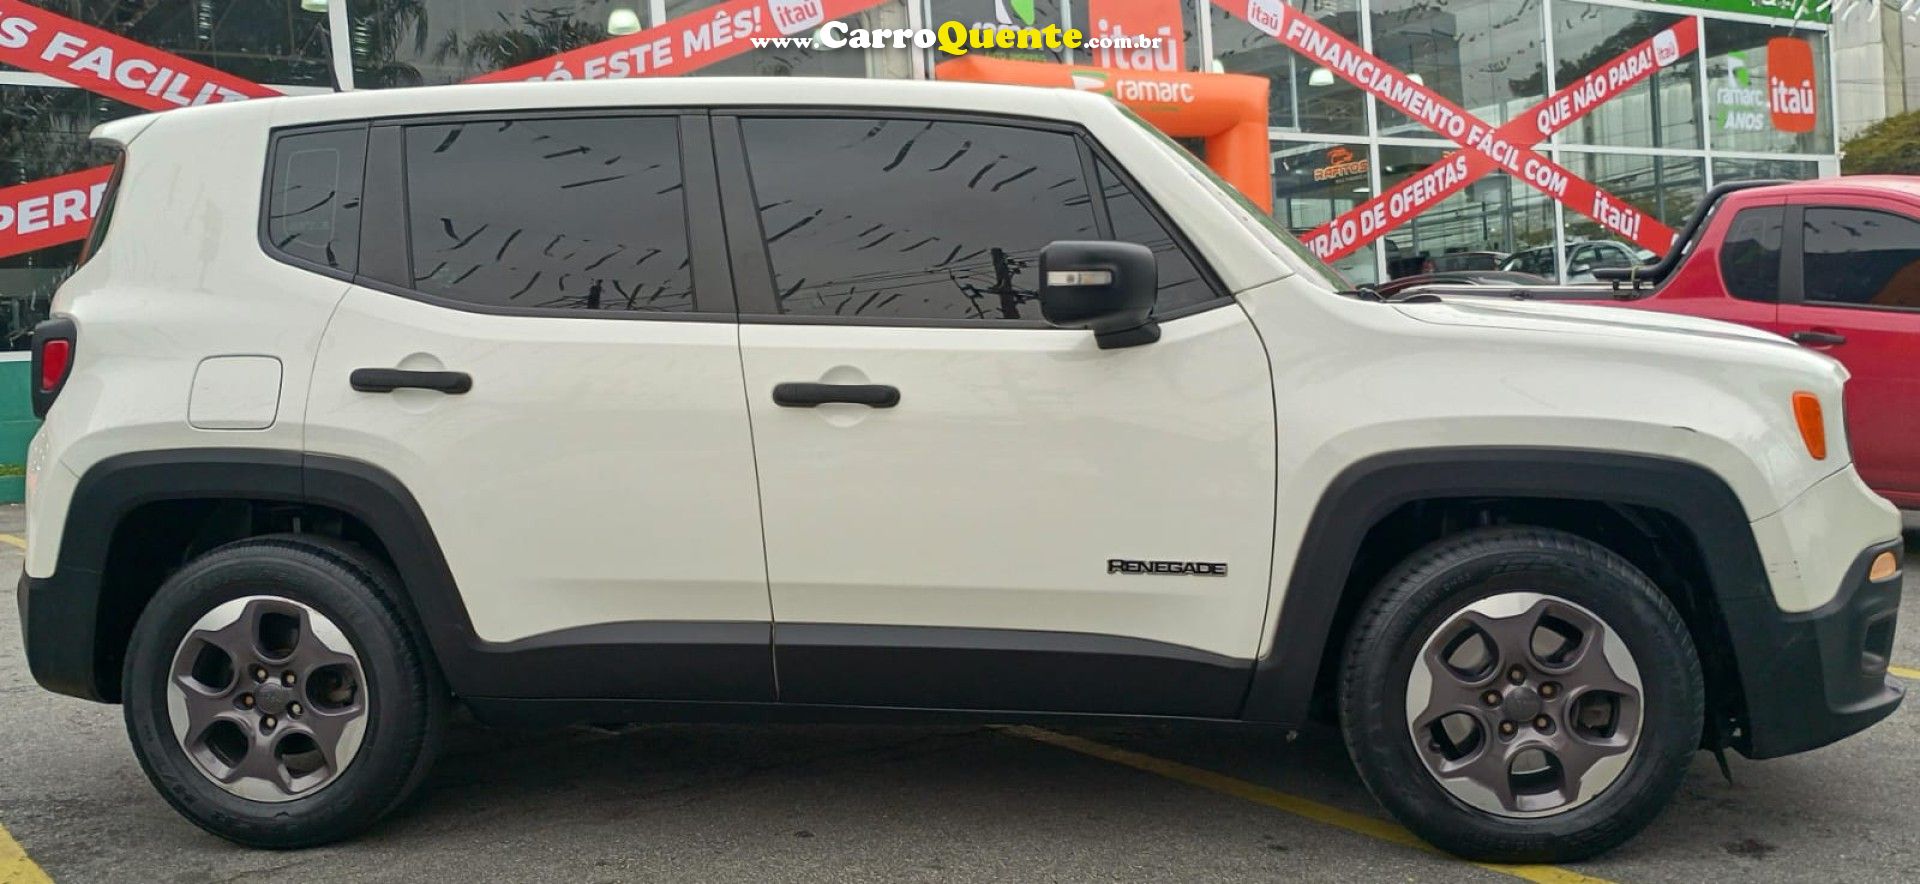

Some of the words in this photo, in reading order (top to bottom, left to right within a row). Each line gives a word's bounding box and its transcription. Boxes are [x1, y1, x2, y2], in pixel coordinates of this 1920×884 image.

[0, 12, 37, 48] S
[584, 37, 672, 80] ESTE
[683, 6, 761, 58] MÊS!
[1116, 80, 1196, 103] ramarc
[1537, 96, 1571, 134] QUE
[1572, 73, 1607, 112] NÃO
[1608, 46, 1652, 90] PARA!
[1717, 88, 1764, 106] ramarc
[1771, 76, 1814, 114] itaú
[1251, 1, 1279, 30] itaú
[1286, 18, 1465, 137] FINANCIAMENTO
[1467, 124, 1519, 172] FÁCIL
[1524, 159, 1568, 197] COM
[1593, 190, 1641, 241] itaú!
[1360, 202, 1387, 237] DE
[1389, 155, 1468, 218] OFERTAS
[1107, 559, 1228, 577] RENEGADE
